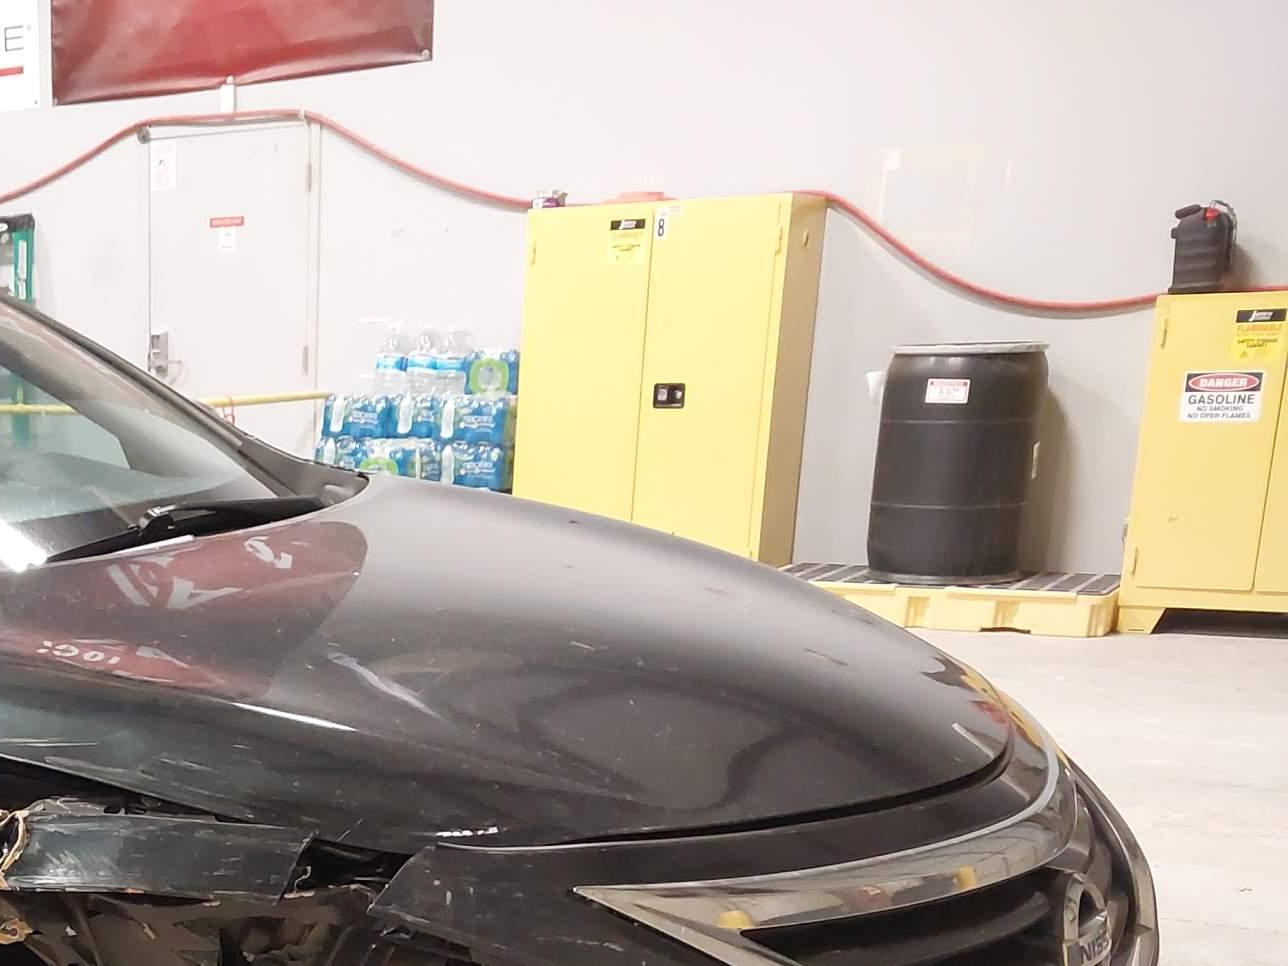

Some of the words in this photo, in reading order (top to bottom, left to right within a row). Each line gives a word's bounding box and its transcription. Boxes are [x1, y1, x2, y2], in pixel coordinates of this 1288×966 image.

[657, 218, 665, 237] 8
[1199, 377, 1248, 388] DANGER
[1188, 393, 1255, 405] GASOLINE
